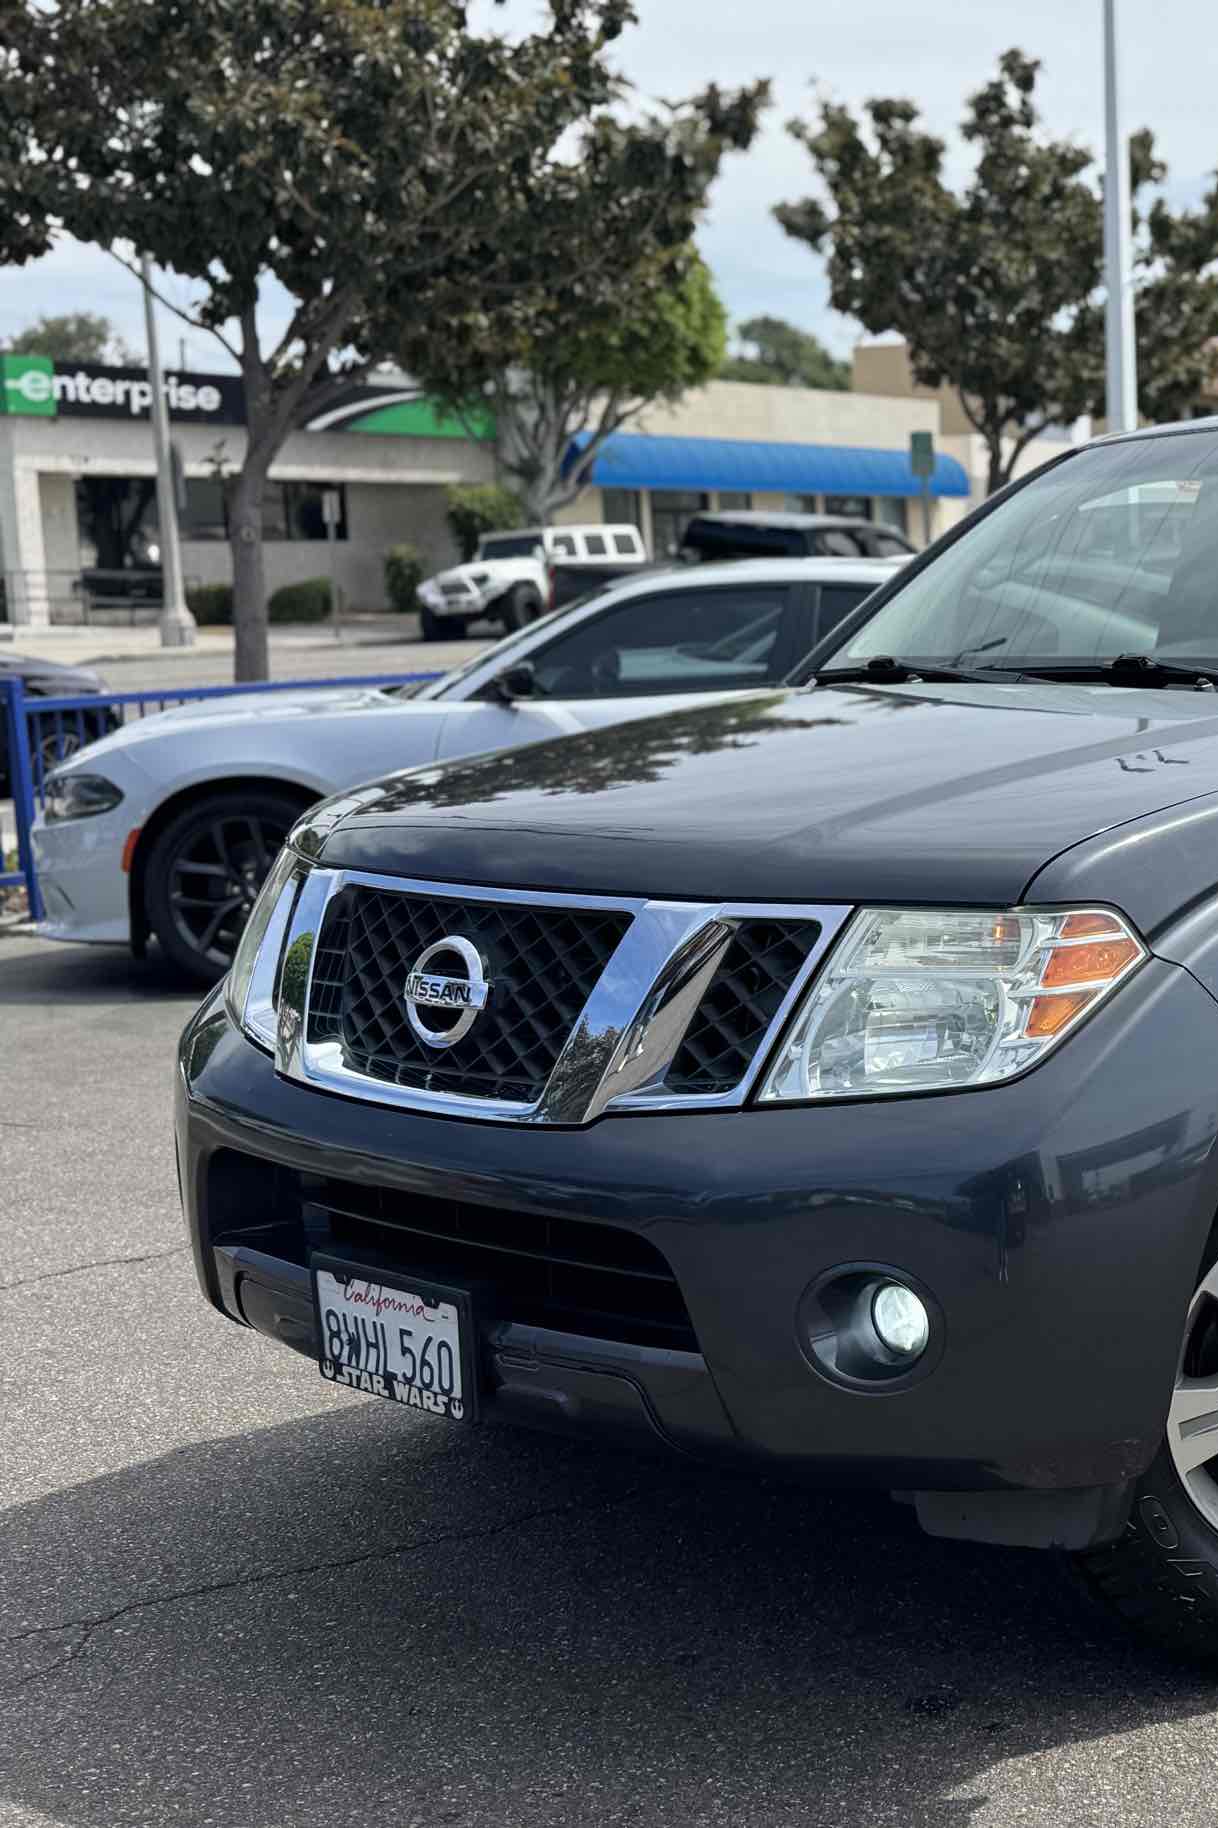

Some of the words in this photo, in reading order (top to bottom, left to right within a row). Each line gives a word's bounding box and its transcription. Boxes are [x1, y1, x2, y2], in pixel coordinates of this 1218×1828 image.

[5, 370, 221, 414] enterpise
[405, 977, 472, 1003] NISSAN
[344, 1278, 435, 1322] California
[336, 1365, 390, 1398] STAR
[393, 1380, 449, 1415] WARS
